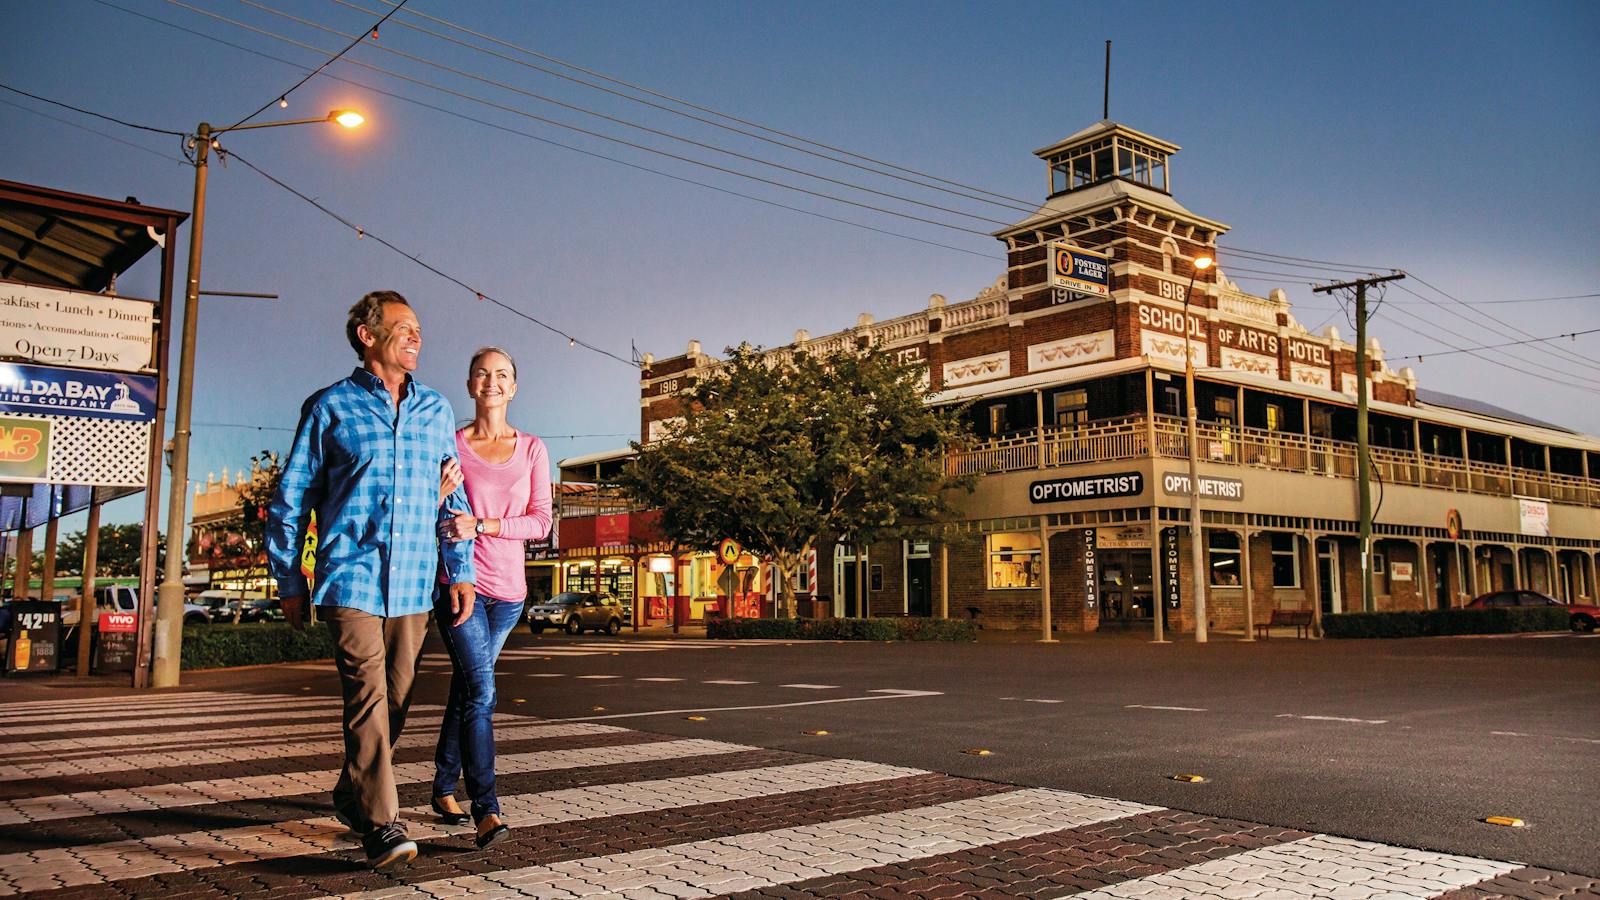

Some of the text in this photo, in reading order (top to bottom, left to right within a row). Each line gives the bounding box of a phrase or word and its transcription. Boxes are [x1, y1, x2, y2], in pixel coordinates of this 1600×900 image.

[1060, 278, 1082, 288] DRIVE
[1078, 266, 1104, 279] LAGER
[1158, 279, 1186, 302] 1918
[56, 301, 94, 317] Lunch
[108, 307, 150, 323] Dinner
[34, 321, 109, 340] Accommodation
[116, 331, 151, 345] Gaming
[1138, 304, 1331, 366] SCHOOL OF ARTS HOTEL
[15, 339, 119, 366] Open 7 Days
[65, 380, 112, 401] BAY
[660, 379, 678, 395] 1918
[0, 394, 31, 403] ING
[39, 396, 107, 409] COMPANY
[1033, 476, 1140, 500] OPTOMETRIST
[1085, 529, 1095, 608] OPTOMETRIST
[1167, 528, 1178, 608] OPTOMETRIST
[108, 615, 134, 624] VIVO
